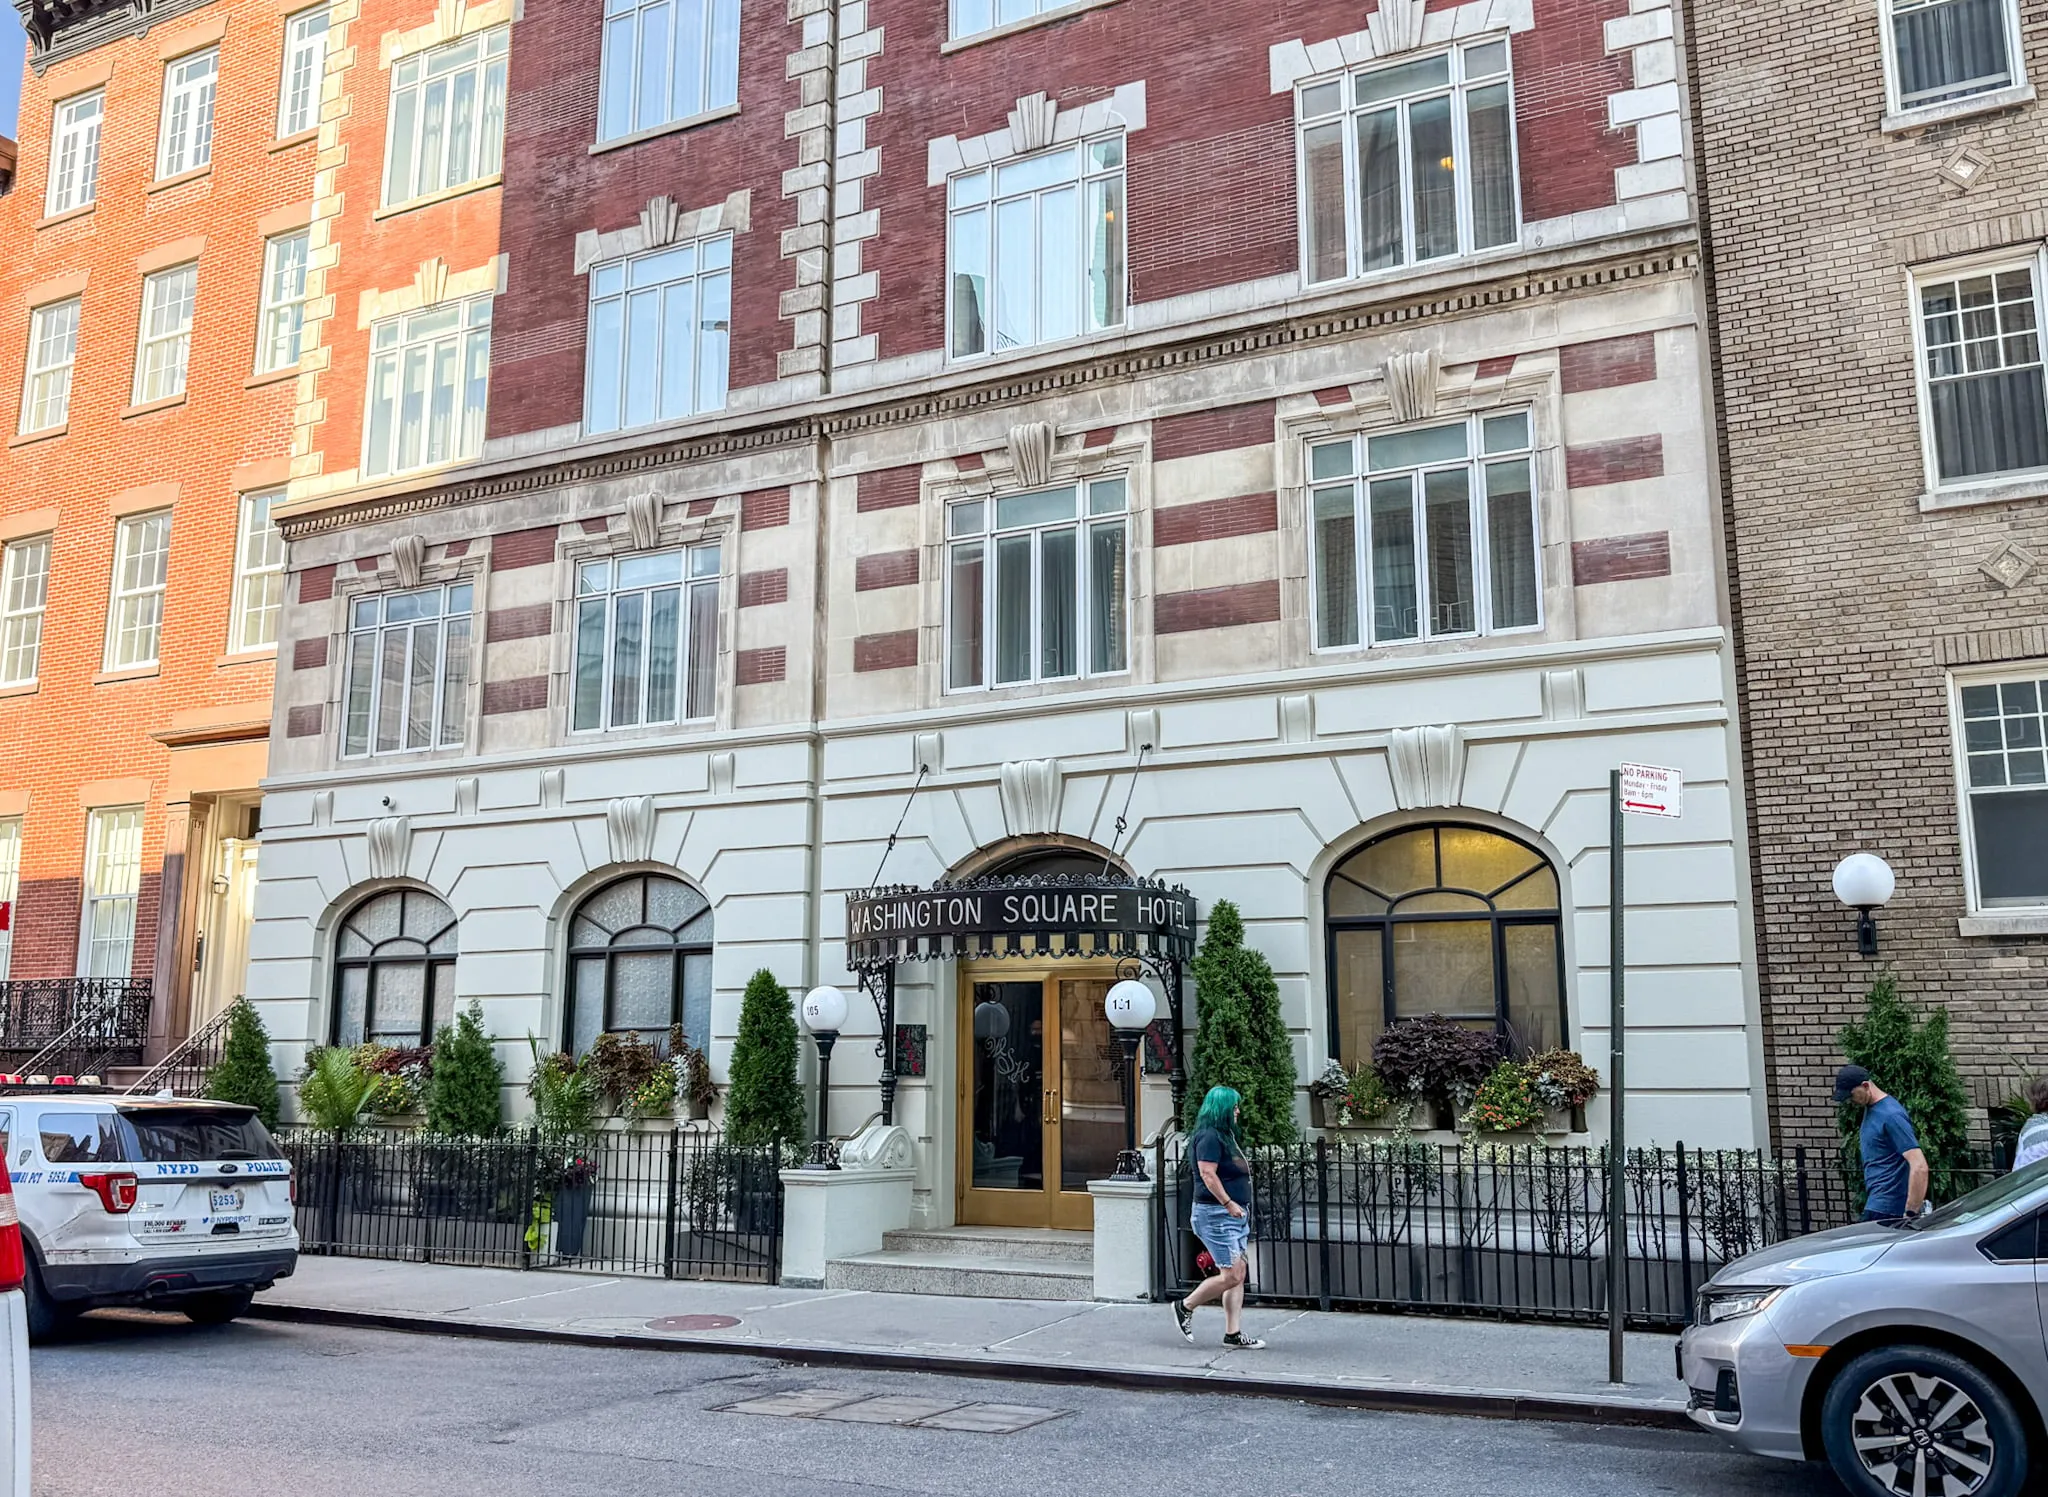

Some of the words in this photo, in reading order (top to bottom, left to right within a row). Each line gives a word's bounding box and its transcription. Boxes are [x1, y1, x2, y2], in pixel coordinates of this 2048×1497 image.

[1623, 767, 1634, 777] NO
[1636, 769, 1668, 782] PARKING
[1623, 779, 1645, 789] Monday
[851, 897, 982, 934] WASHINGTON
[1002, 894, 1118, 924] SQUARE
[1137, 896, 1190, 930] HOTEL
[156, 1164, 199, 1175] NYPD
[245, 1162, 284, 1173] POLICE
